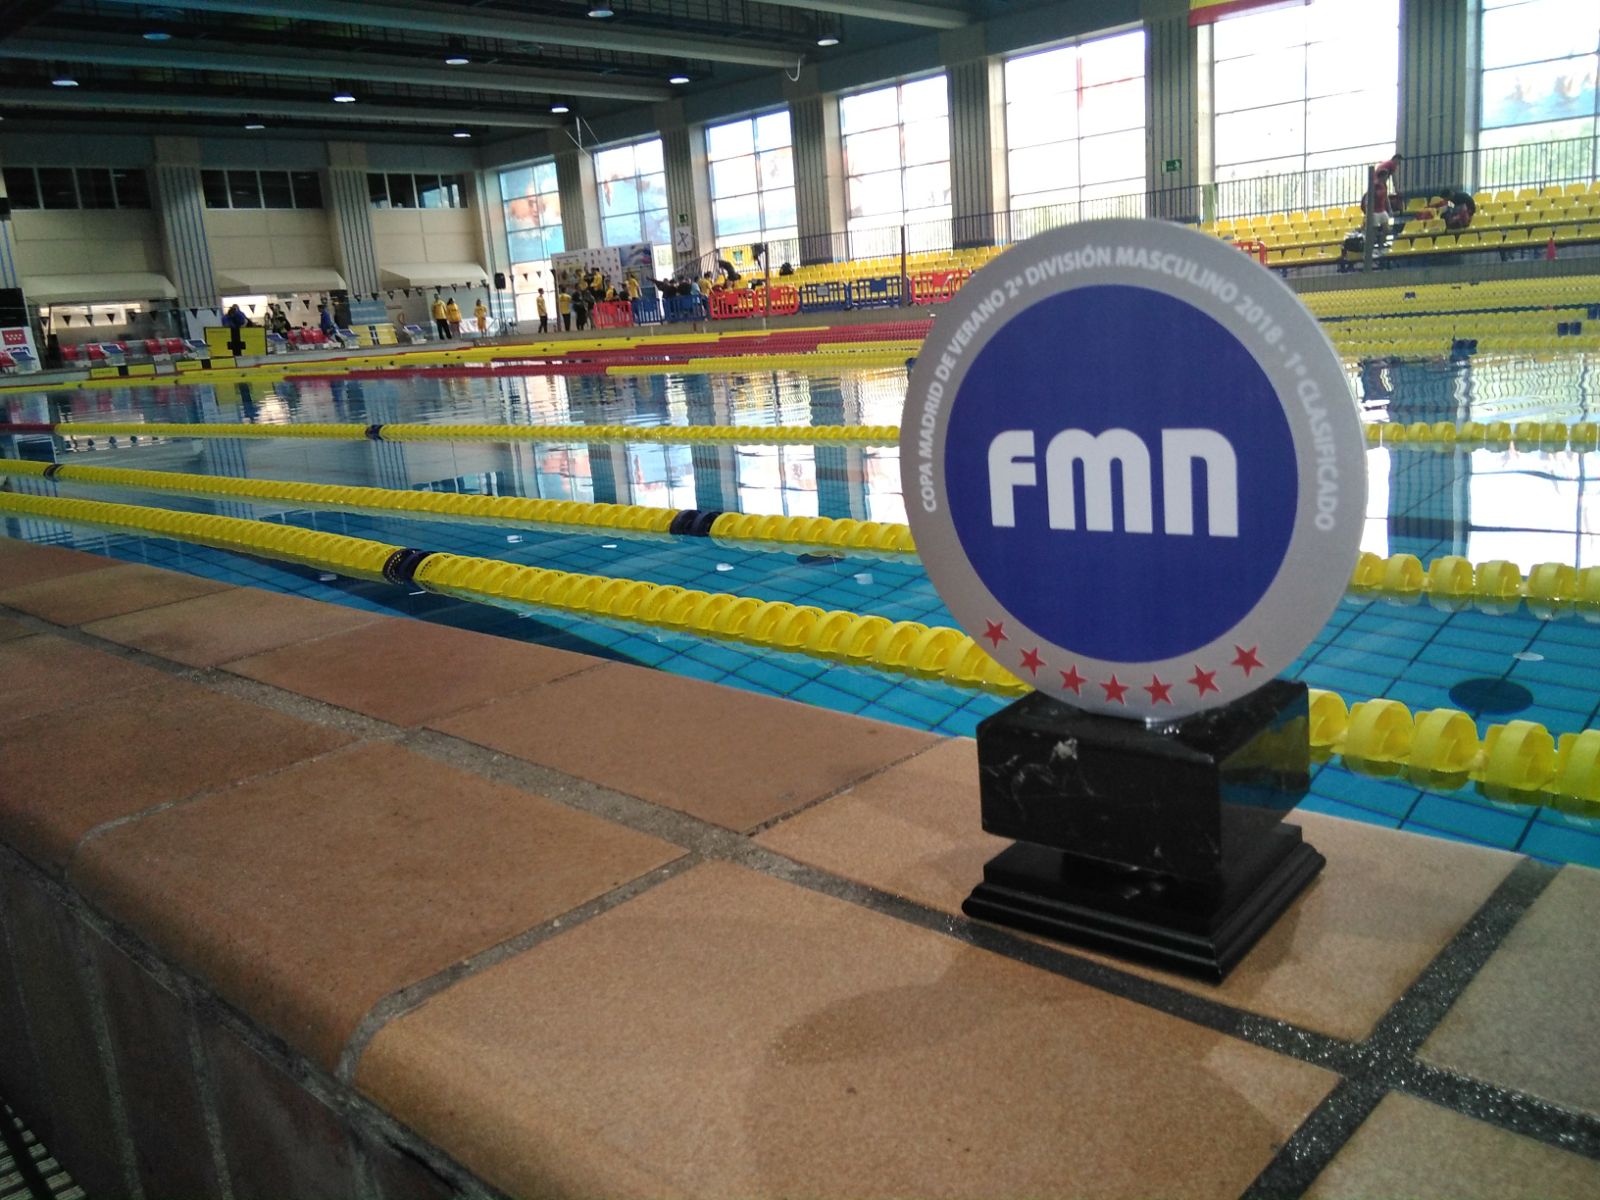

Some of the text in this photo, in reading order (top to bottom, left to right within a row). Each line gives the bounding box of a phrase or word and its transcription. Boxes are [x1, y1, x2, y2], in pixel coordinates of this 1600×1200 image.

[1025, 244, 1112, 286] DIVISIÓN
[1115, 246, 1238, 303] MASCULINO
[948, 289, 1005, 356] VERANO
[1234, 295, 1284, 344] 2018
[934, 353, 957, 381] DE
[919, 381, 943, 458] MADRID
[1297, 379, 1339, 532] CLASIFICADO
[919, 462, 937, 513] COPA
